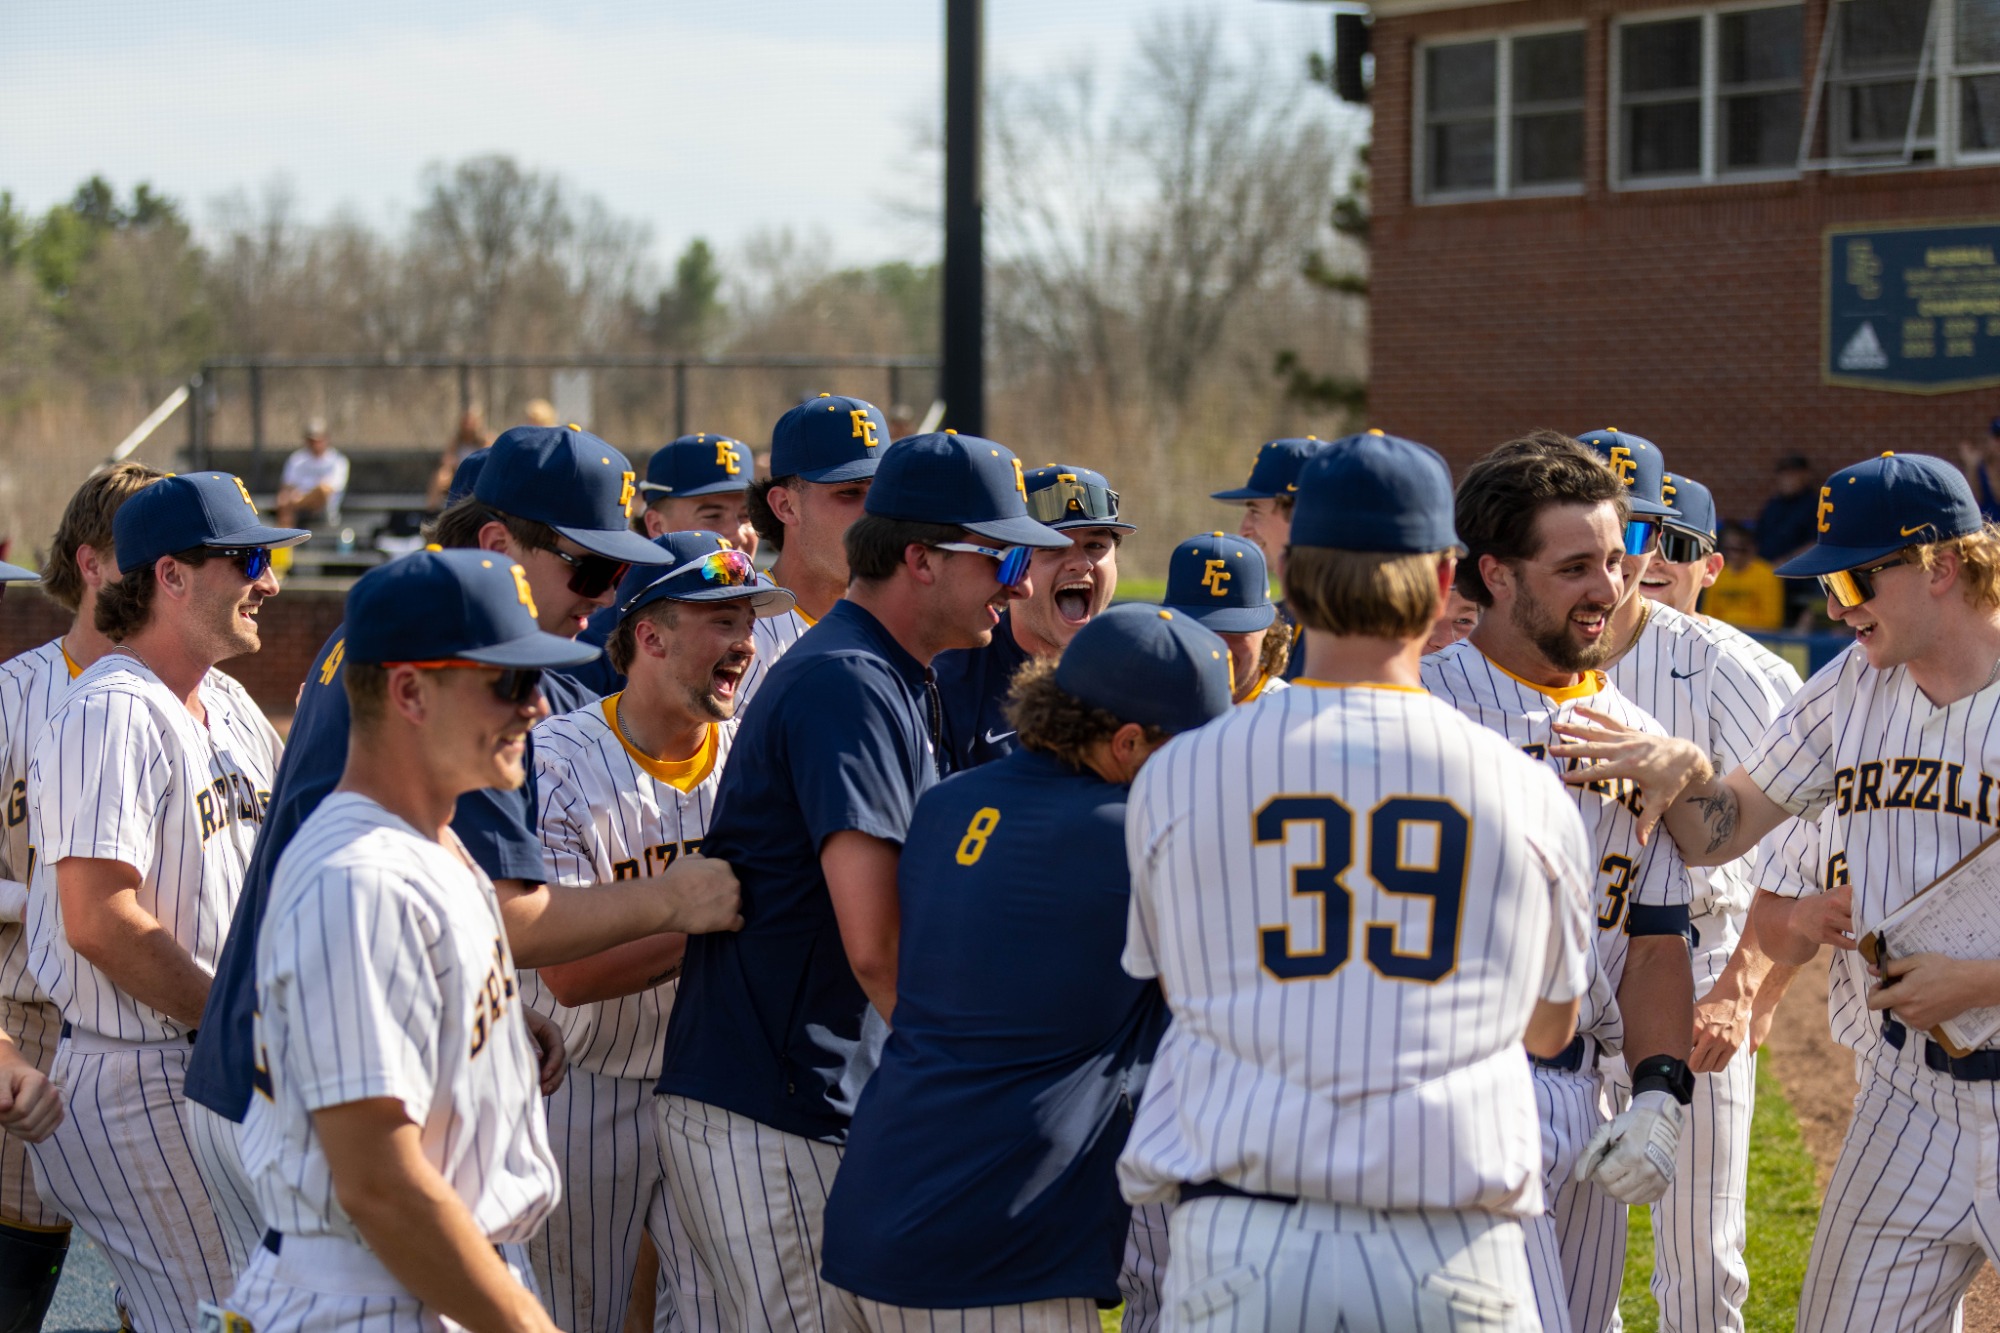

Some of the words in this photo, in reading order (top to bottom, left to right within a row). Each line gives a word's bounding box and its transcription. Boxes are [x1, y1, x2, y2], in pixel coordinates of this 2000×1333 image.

[850, 409, 879, 448] FC
[715, 441, 741, 475] FC
[619, 471, 636, 519] FC
[1816, 486, 1834, 533] FC
[1201, 559, 1232, 597] FC
[956, 807, 1000, 866] 8
[1252, 793, 1474, 986] 39
